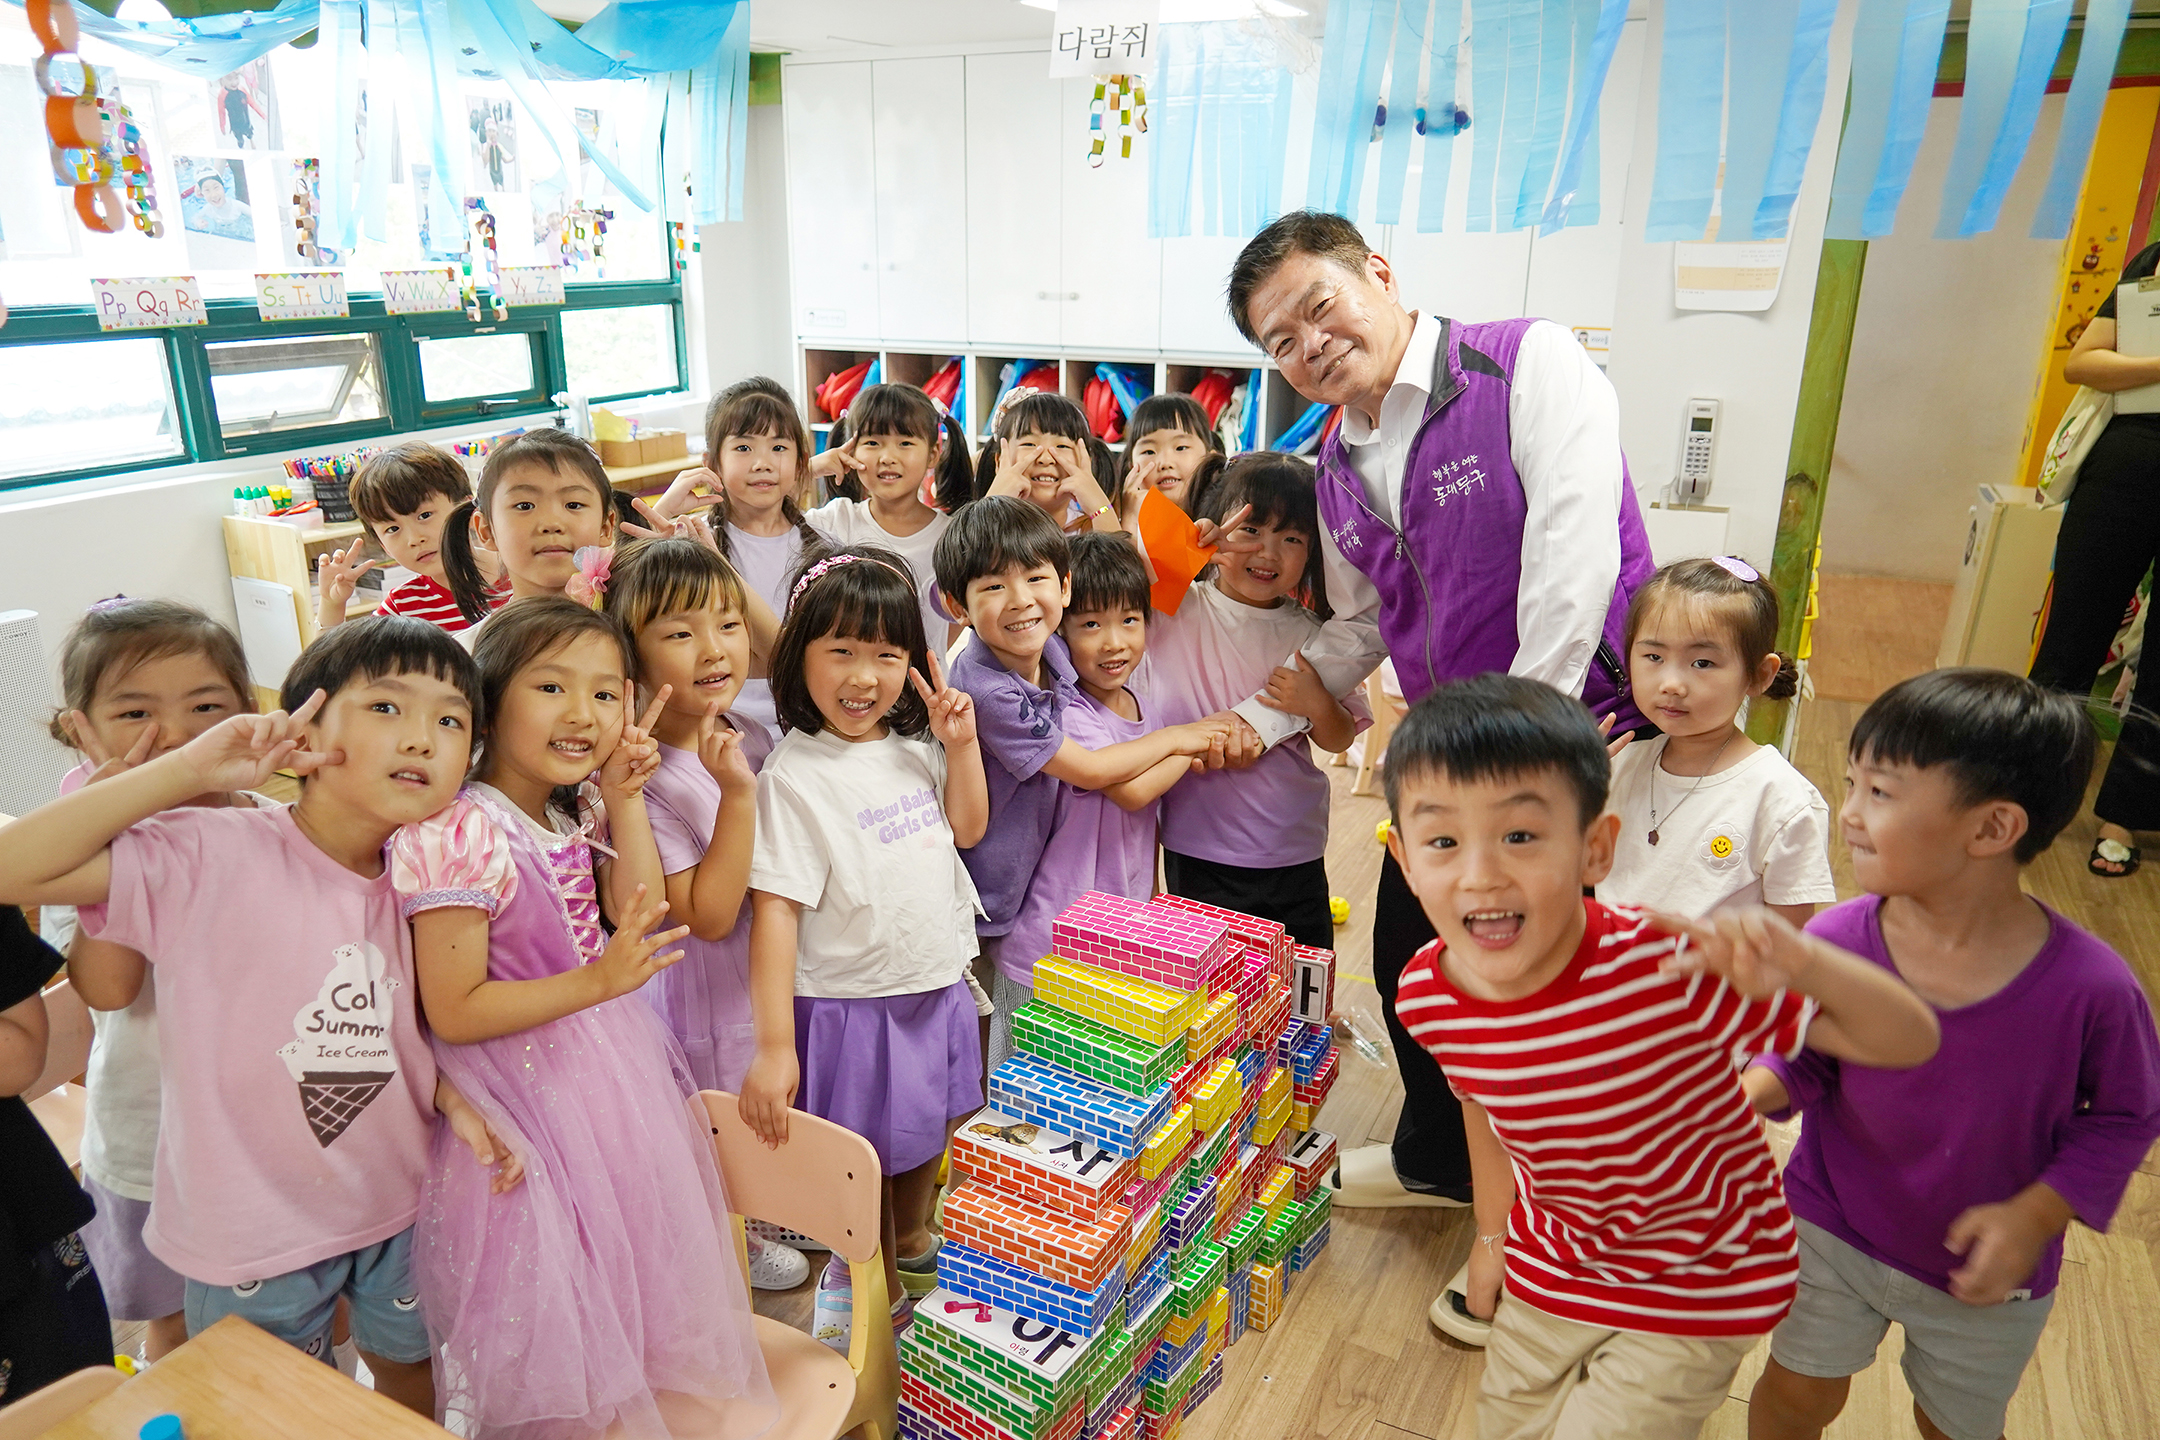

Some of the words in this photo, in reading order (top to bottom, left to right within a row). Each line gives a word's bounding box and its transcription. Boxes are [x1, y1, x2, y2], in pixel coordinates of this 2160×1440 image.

[1059, 22, 1149, 61] 다람쥐
[263, 286, 286, 307] Ss
[292, 285, 312, 306] Tt
[319, 284, 343, 305] Uu
[386, 282, 406, 301] Vv
[437, 281, 450, 299] X
[535, 276, 553, 294] Zz
[101, 292, 127, 320] Pp
[137, 290, 169, 317] Qq
[175, 289, 200, 312] Rr
[1432, 469, 1486, 507] 동대문구
[857, 802, 900, 830] New
[879, 815, 921, 844] Girls
[306, 1009, 385, 1038] Summ
[316, 1045, 341, 1058] Ice
[345, 1045, 389, 1058] Cream
[1049, 1140, 1115, 1176] 사
